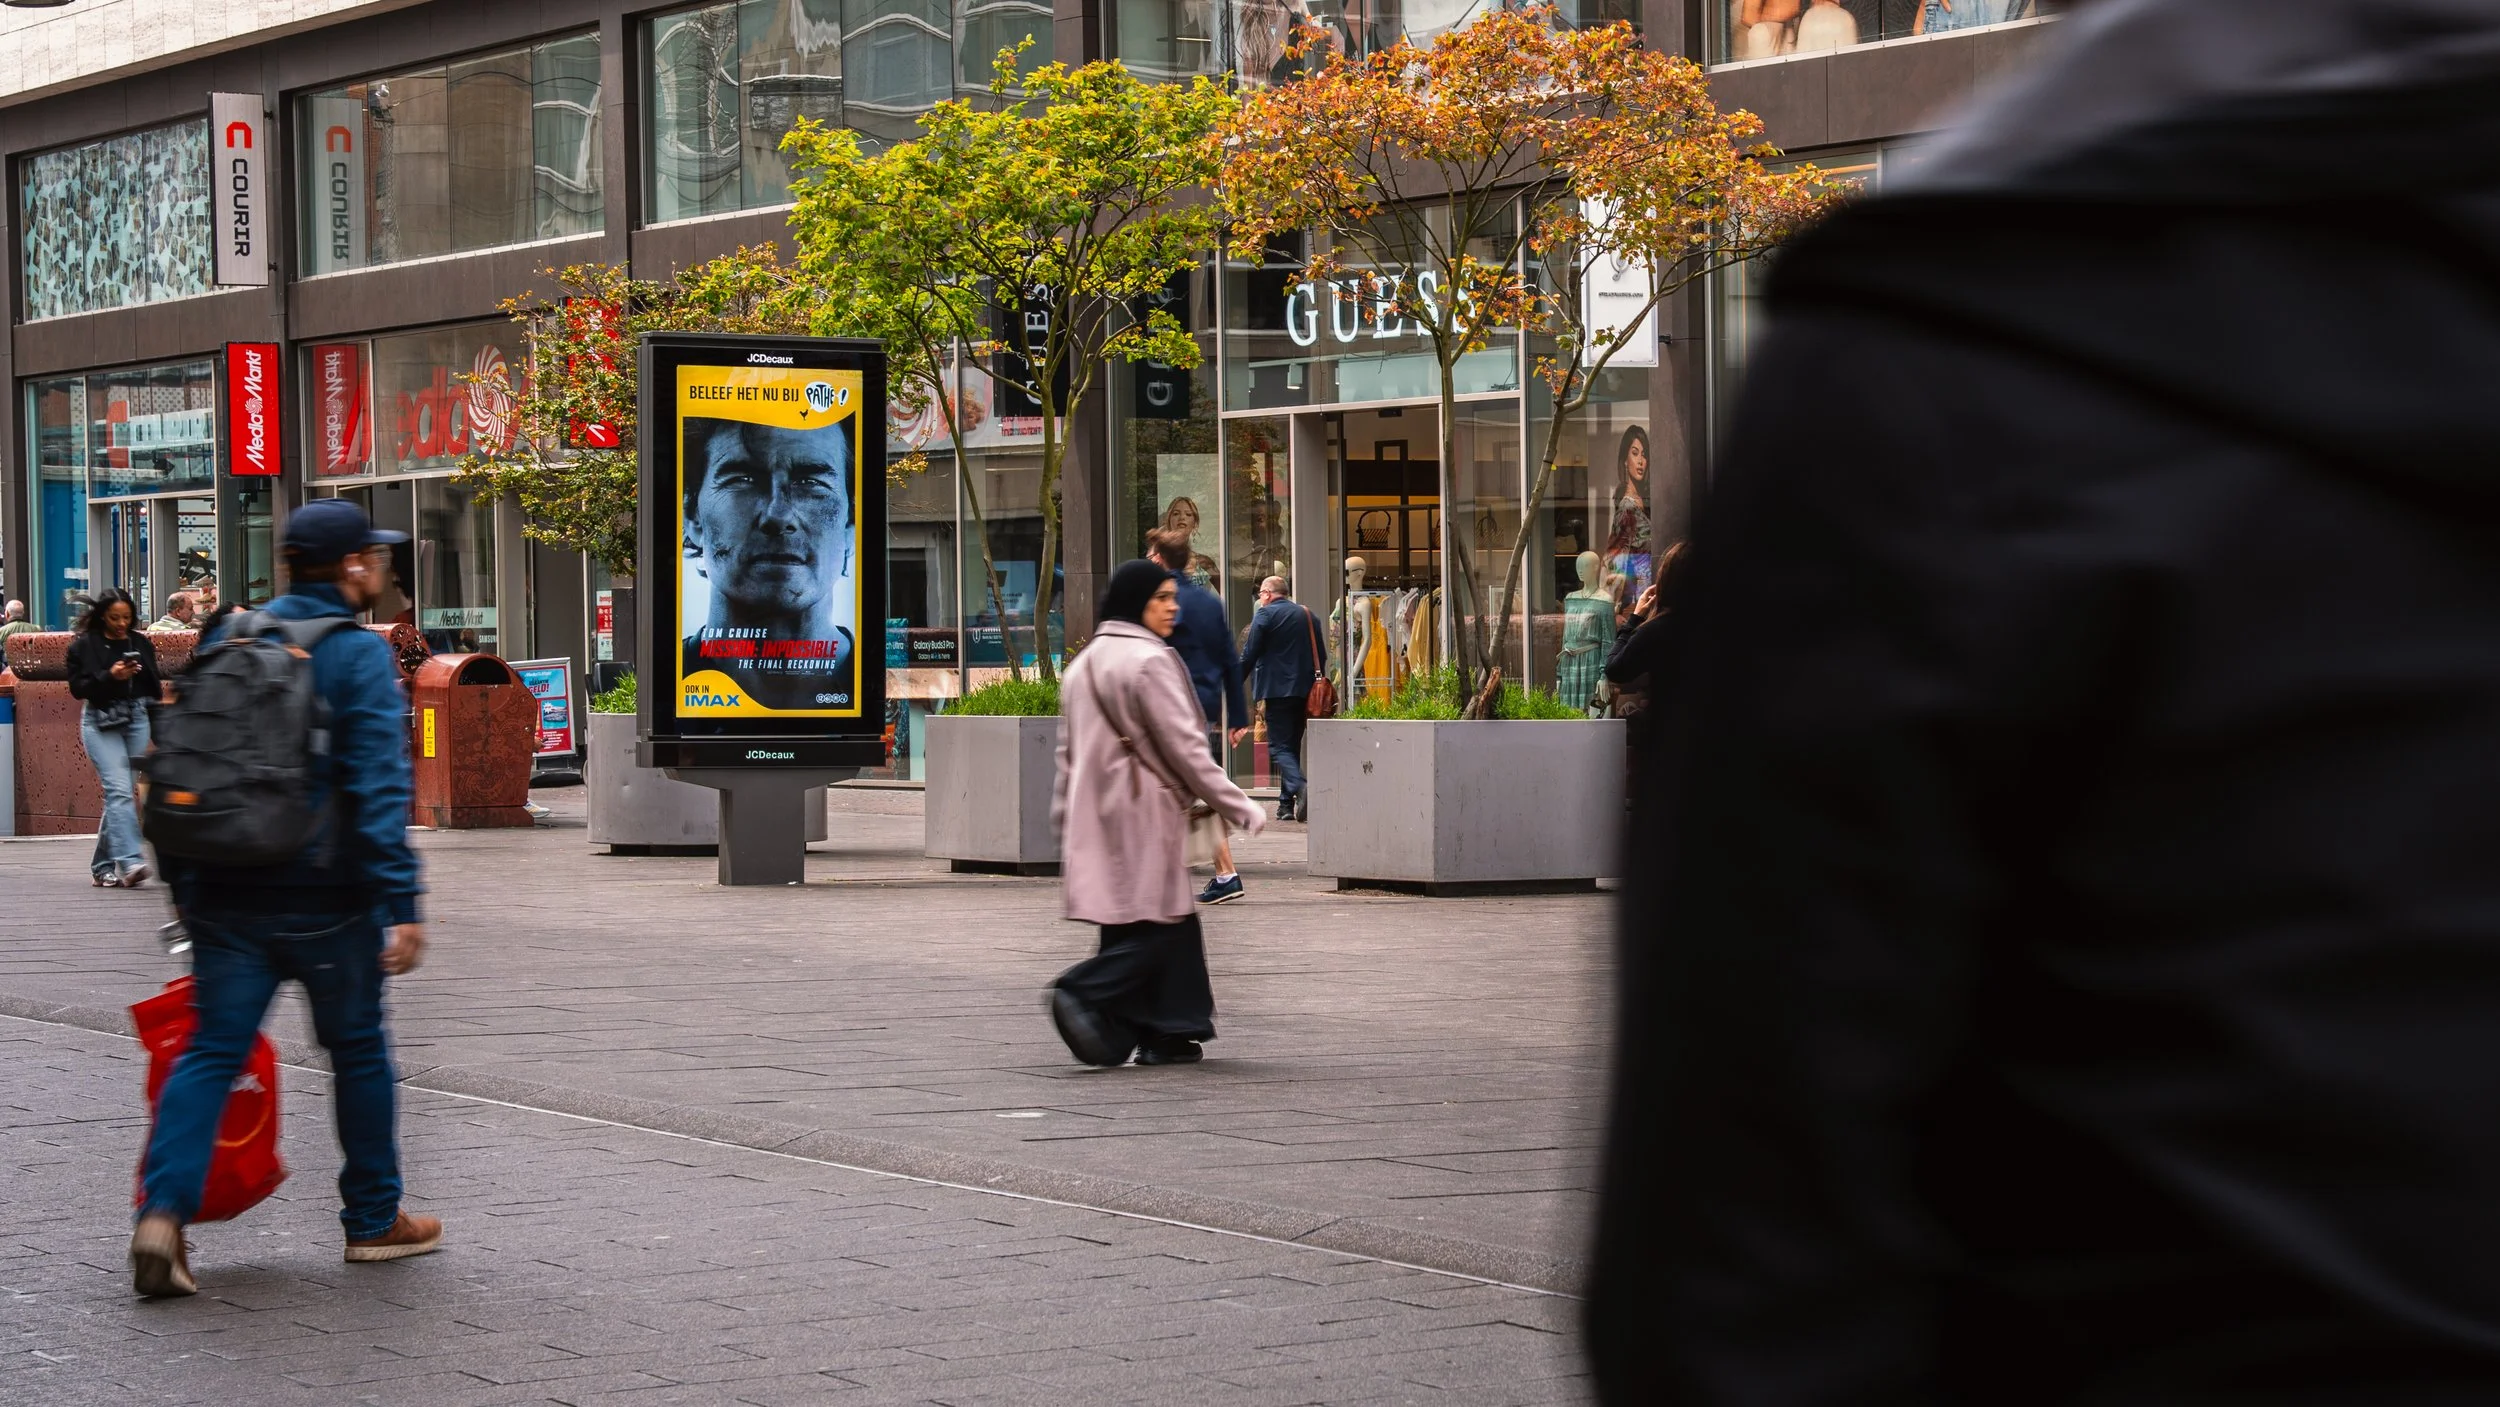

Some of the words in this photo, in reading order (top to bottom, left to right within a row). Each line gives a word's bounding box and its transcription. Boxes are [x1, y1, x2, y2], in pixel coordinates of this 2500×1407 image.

[232, 158, 250, 257] COURIR
[746, 353, 794, 364] JCDecaux
[689, 385, 733, 400] BELEEF
[737, 387, 759, 401] HET
[762, 388, 779, 401] NU
[783, 388, 799, 402] BIJ
[702, 627, 722, 638] TOM
[728, 628, 768, 638] CRUISE
[700, 639, 759, 658] MISSION:
[761, 639, 839, 658] IMPOSSIBLE
[946, 640, 955, 649] Pro
[738, 659, 753, 669] THE
[758, 659, 783, 669] FINAL
[787, 659, 836, 670] RECKONING
[685, 684, 700, 694] OOK
[701, 684, 710, 694] IN
[685, 694, 740, 707] IMAX
[745, 750, 795, 760] JCDecaux
